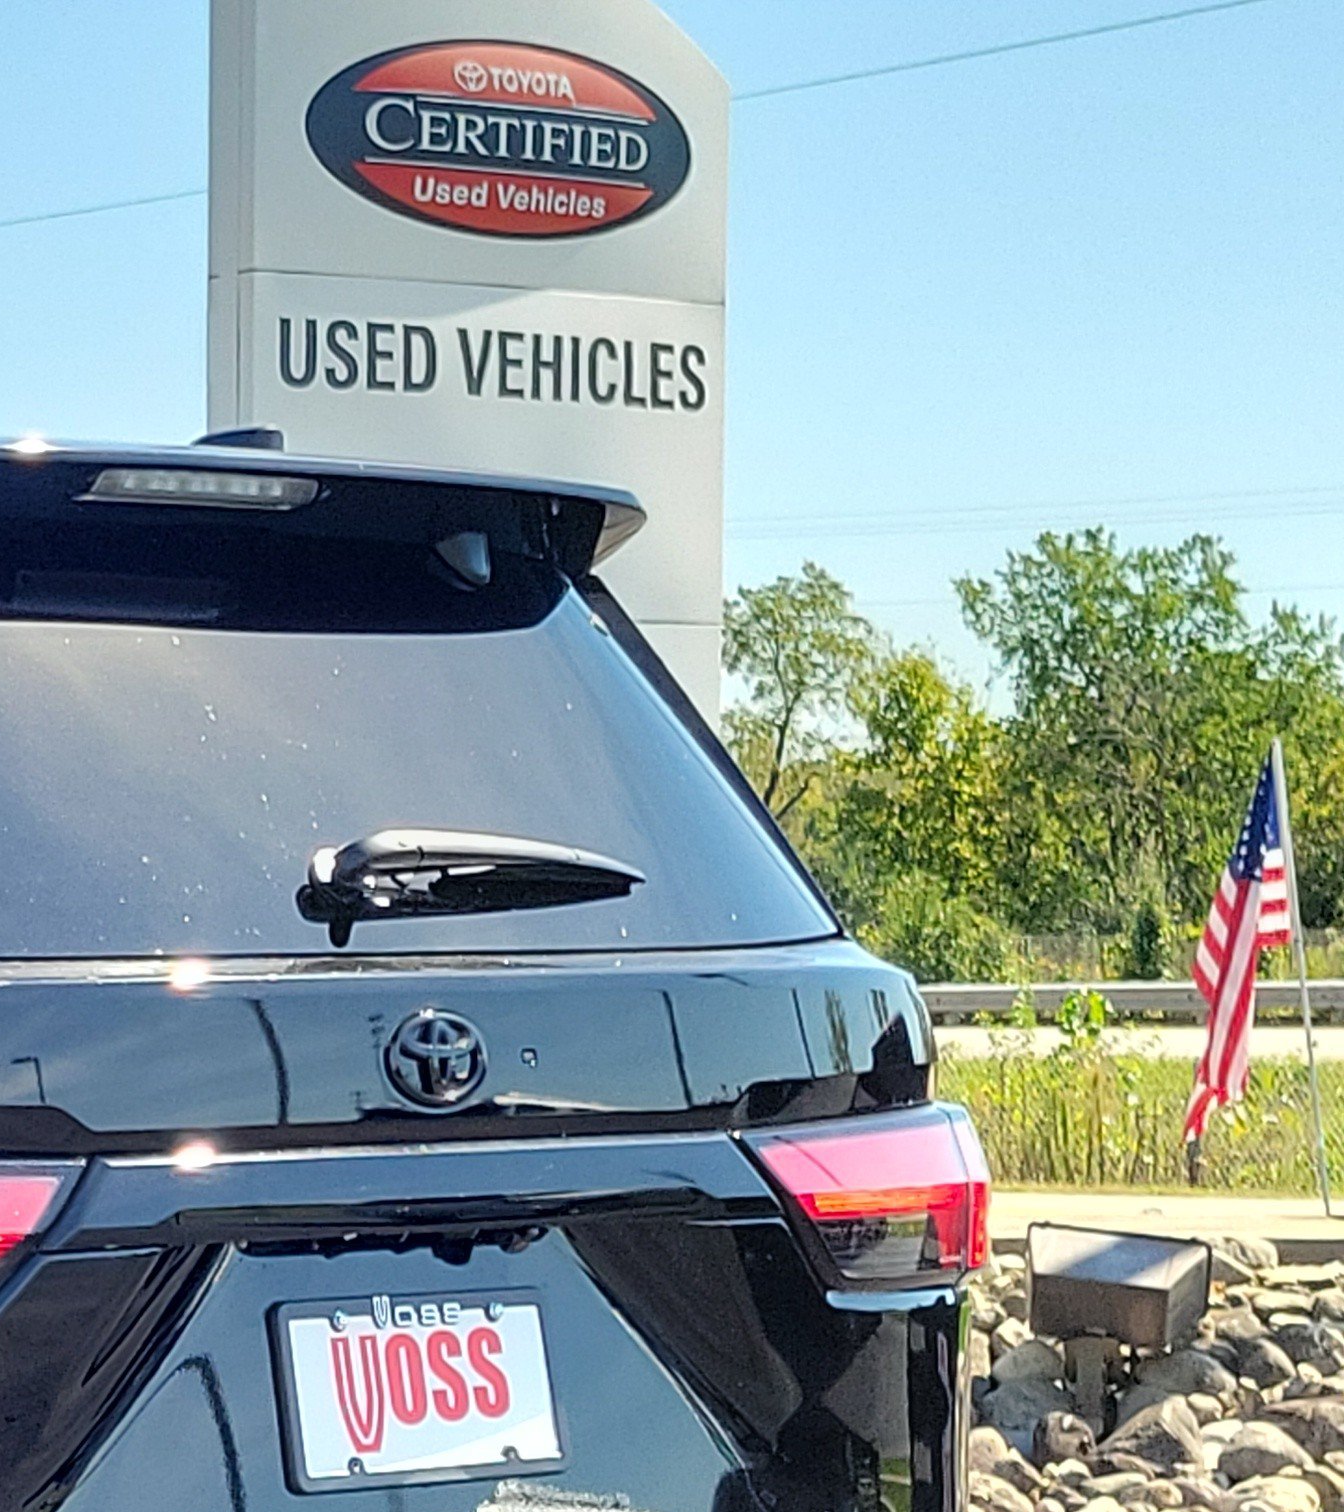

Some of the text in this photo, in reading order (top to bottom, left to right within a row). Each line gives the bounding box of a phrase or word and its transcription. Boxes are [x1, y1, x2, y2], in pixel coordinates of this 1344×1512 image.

[488, 66, 575, 99] TOYOTA
[365, 98, 650, 173] CERTIFIED
[414, 175, 607, 219] Used Vehicles
[278, 316, 707, 411] USED VEHICLES
[331, 1326, 511, 1454] VOSS
